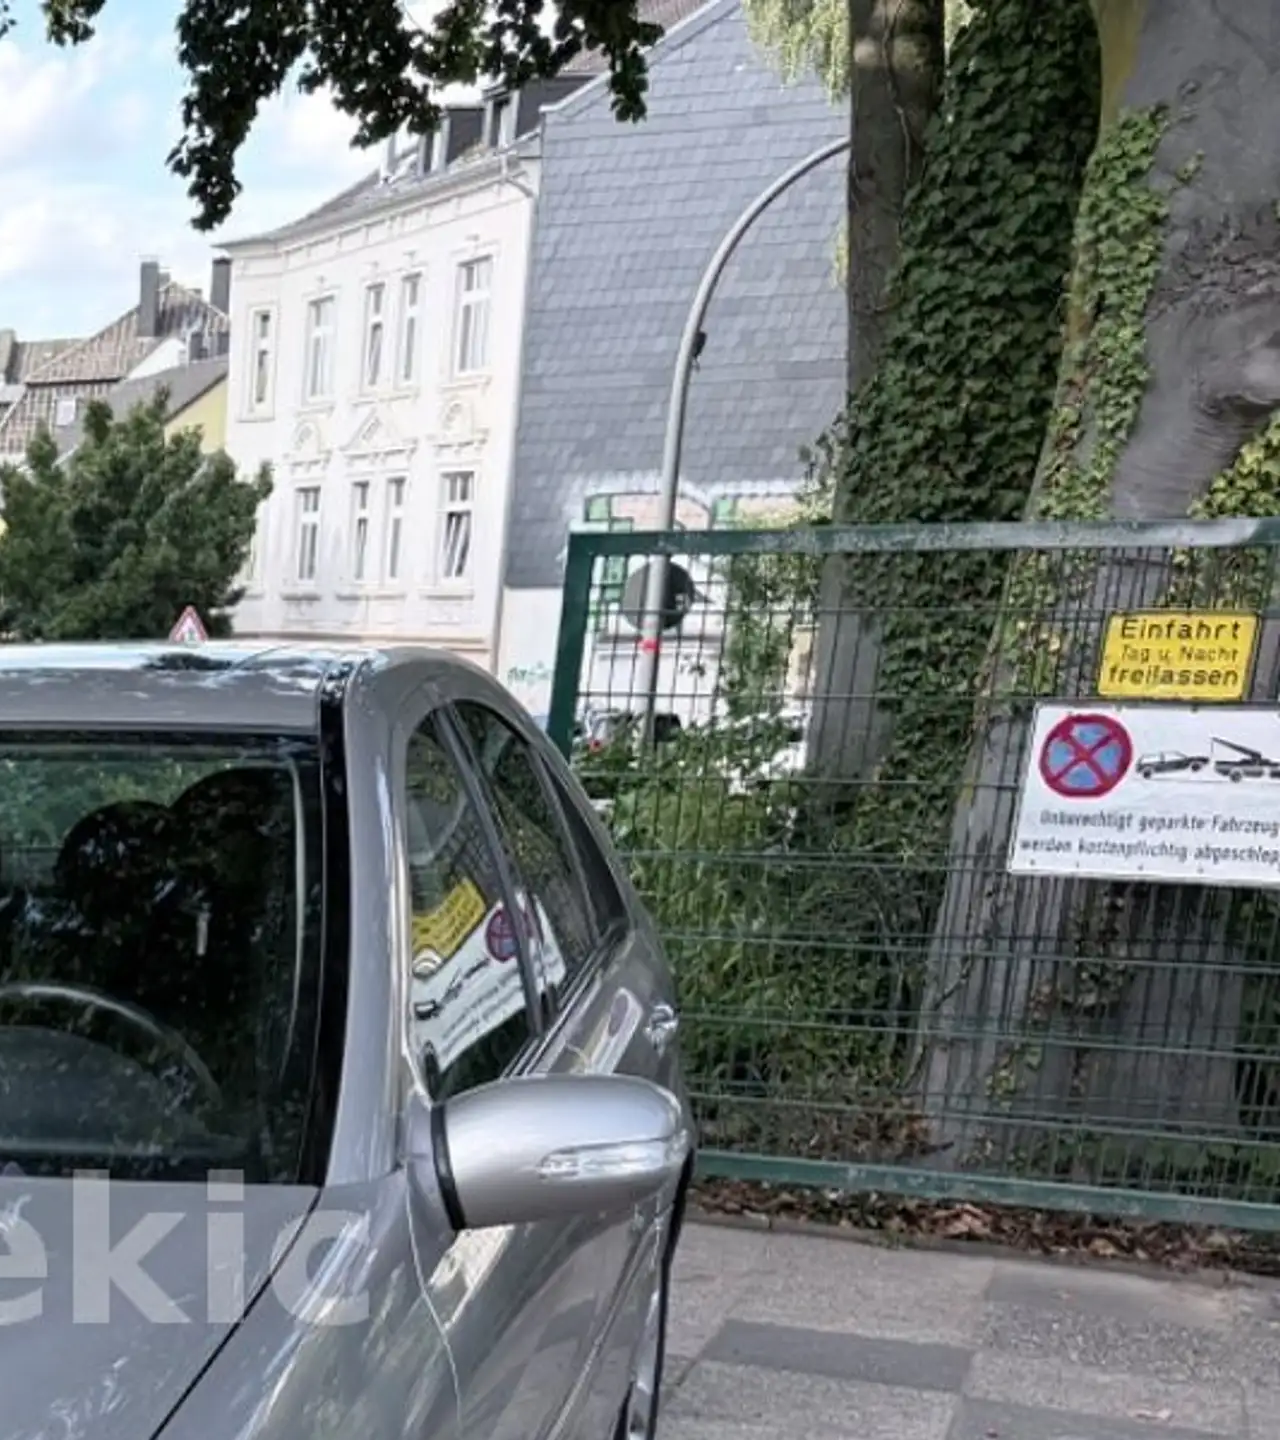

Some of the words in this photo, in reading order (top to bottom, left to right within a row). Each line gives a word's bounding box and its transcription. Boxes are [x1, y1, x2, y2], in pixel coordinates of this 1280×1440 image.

[1120, 618, 1242, 641] Einfahrt
[1120, 644, 1151, 664] Tag
[1179, 645, 1239, 663] Nacht
[1108, 664, 1239, 687] freilassen
[1040, 809, 1134, 832] Unberechtigt
[1139, 812, 1206, 833] geparkte
[1020, 836, 1073, 853] werden
[1078, 838, 1189, 861] kostenpflichtig
